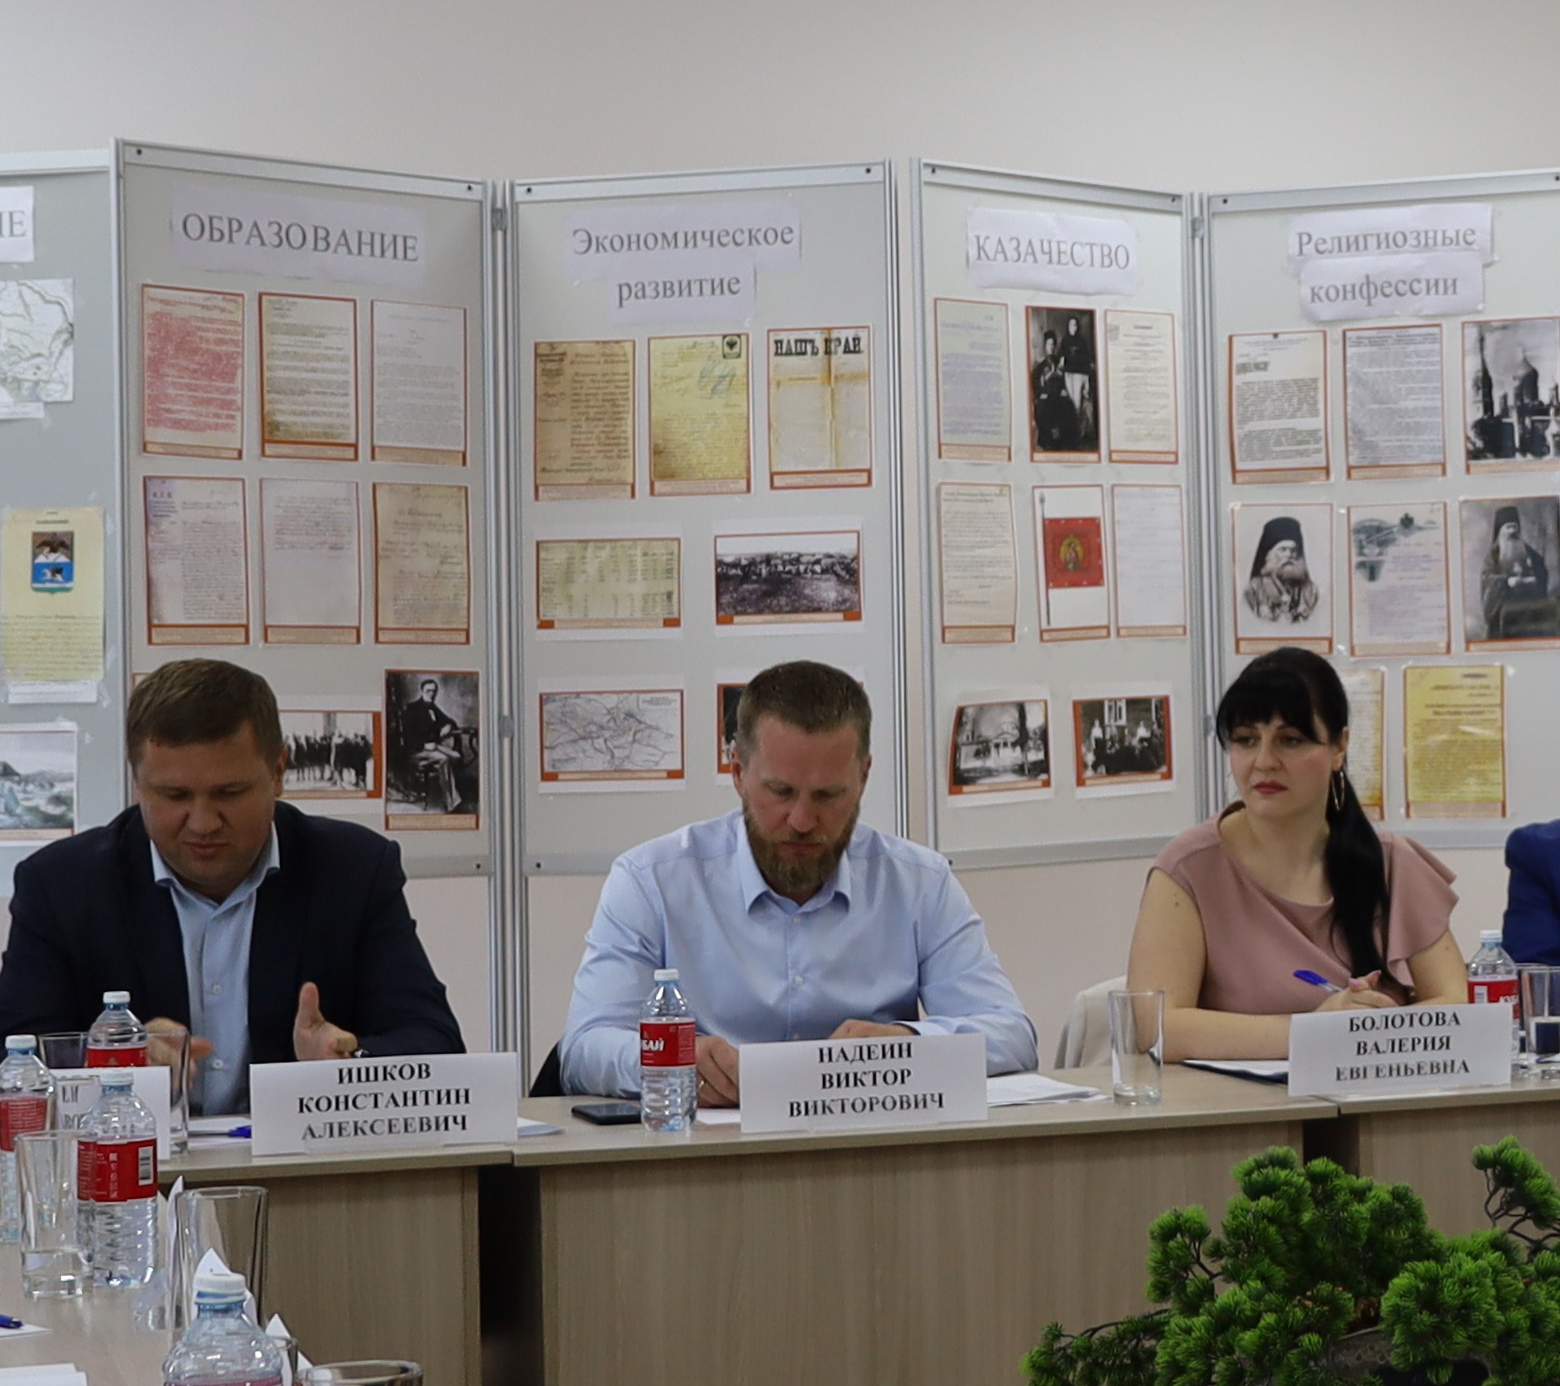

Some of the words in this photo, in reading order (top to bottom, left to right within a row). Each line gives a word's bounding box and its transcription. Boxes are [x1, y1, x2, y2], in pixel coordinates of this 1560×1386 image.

[182, 213, 420, 262] ОБРАЗОВАНИЕ
[572, 225, 795, 255] Экономическое
[1296, 227, 1477, 256] Религиозные
[974, 234, 1130, 270] КАЗАЧЕСТВО
[616, 275, 741, 309] развитие
[1309, 273, 1458, 307] конфессии
[774, 338, 819, 356] НАШЪ
[1348, 1011, 1461, 1033] БОЛОТОВА
[817, 1042, 913, 1064] НАДЕИН
[1356, 1035, 1451, 1056] ВАЛЕРИЯ
[337, 1063, 432, 1085] ИШКОВ
[821, 1068, 912, 1090] ВИКТОР
[1335, 1059, 1470, 1082] ЕВГЕНЬЕВНА
[298, 1088, 471, 1114] КОНСТАНТИН
[788, 1092, 945, 1119] ВИКТОРОВИЧ
[301, 1115, 468, 1141] АЛЕКСЕЕВИЧ
